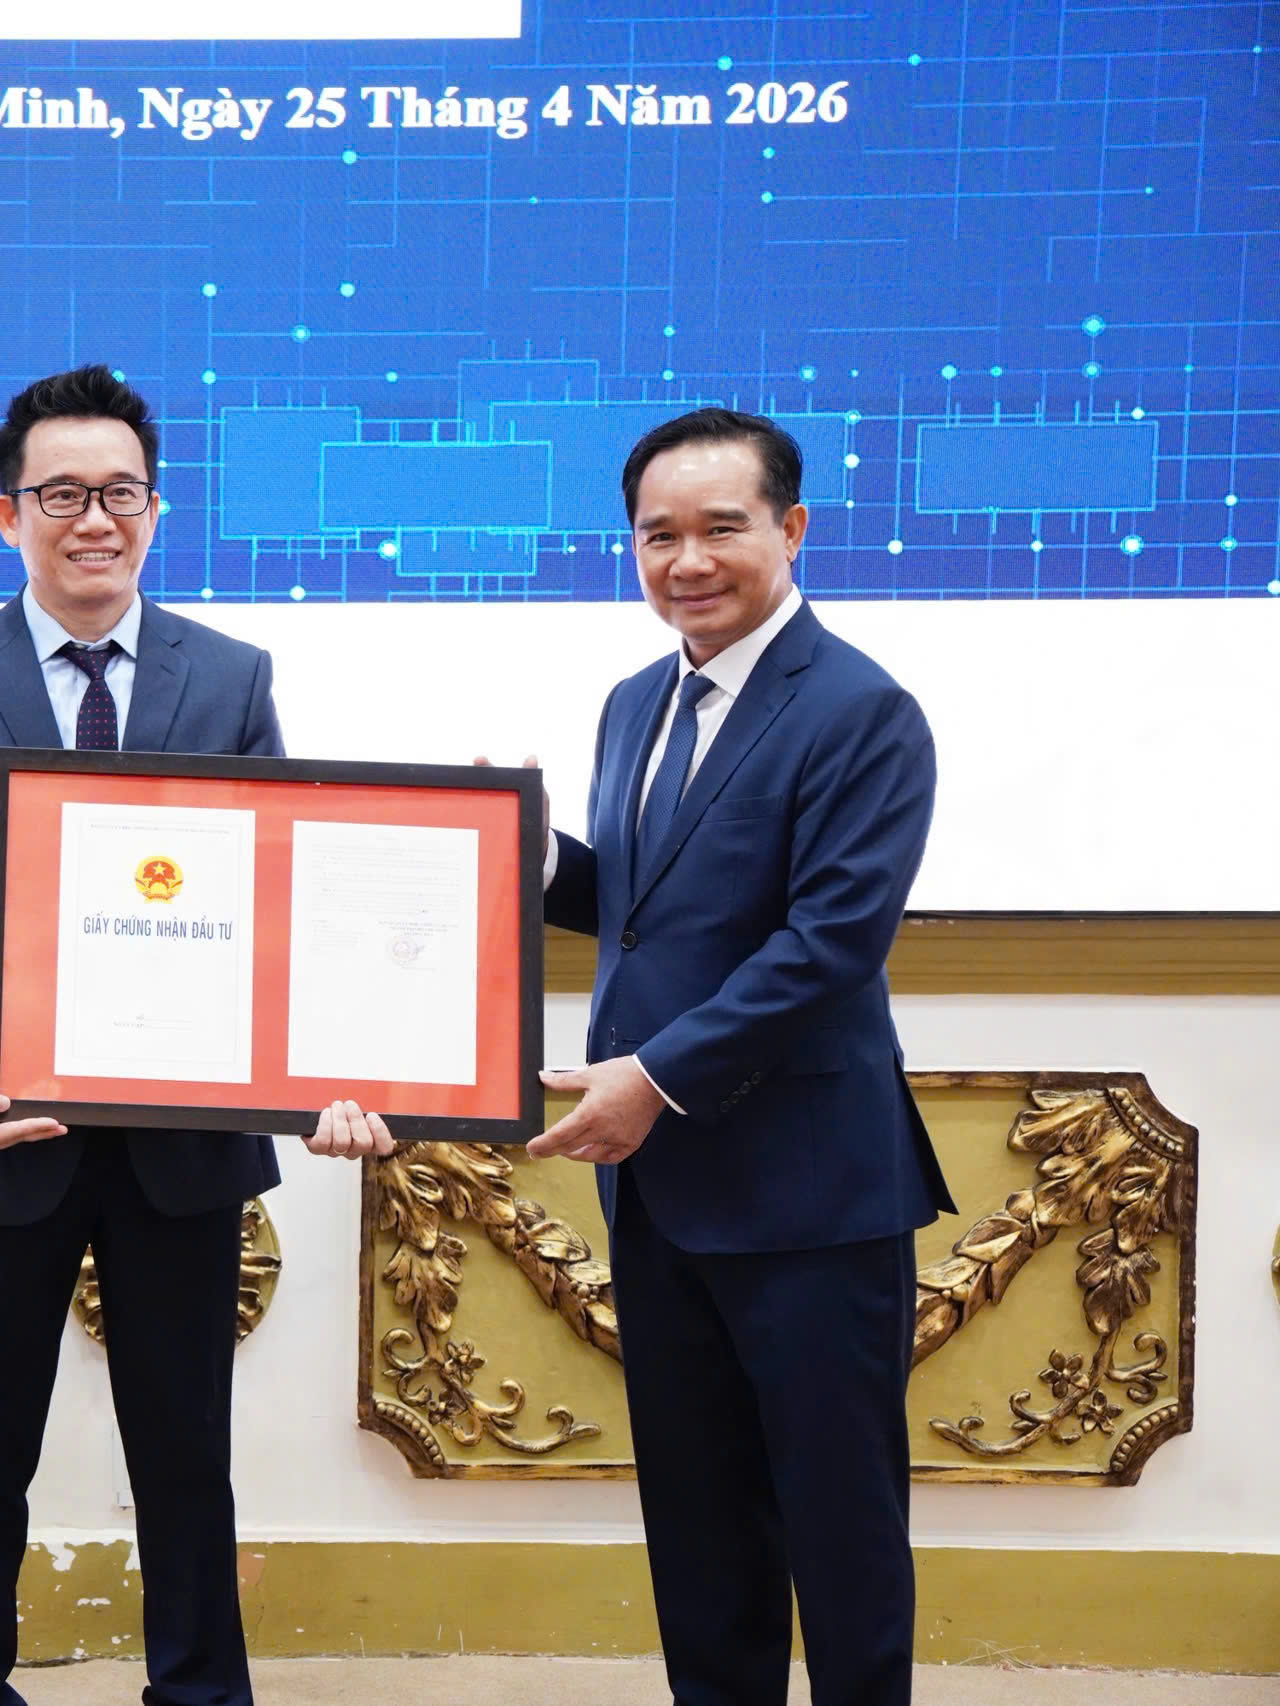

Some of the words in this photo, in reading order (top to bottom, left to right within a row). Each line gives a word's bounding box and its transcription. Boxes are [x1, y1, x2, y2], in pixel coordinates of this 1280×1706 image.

[137, 87, 273, 141] Ngày
[285, 87, 347, 129] 25
[360, 86, 529, 140] Tháng
[541, 85, 573, 127] 4
[585, 84, 713, 126] Năm
[725, 80, 849, 125] 2026
[83, 911, 109, 935] GIẤY
[114, 914, 152, 938] CHỨNG
[156, 916, 187, 941] NHẬN
[192, 914, 214, 940] ĐẦU
[218, 920, 233, 941] TƯ
